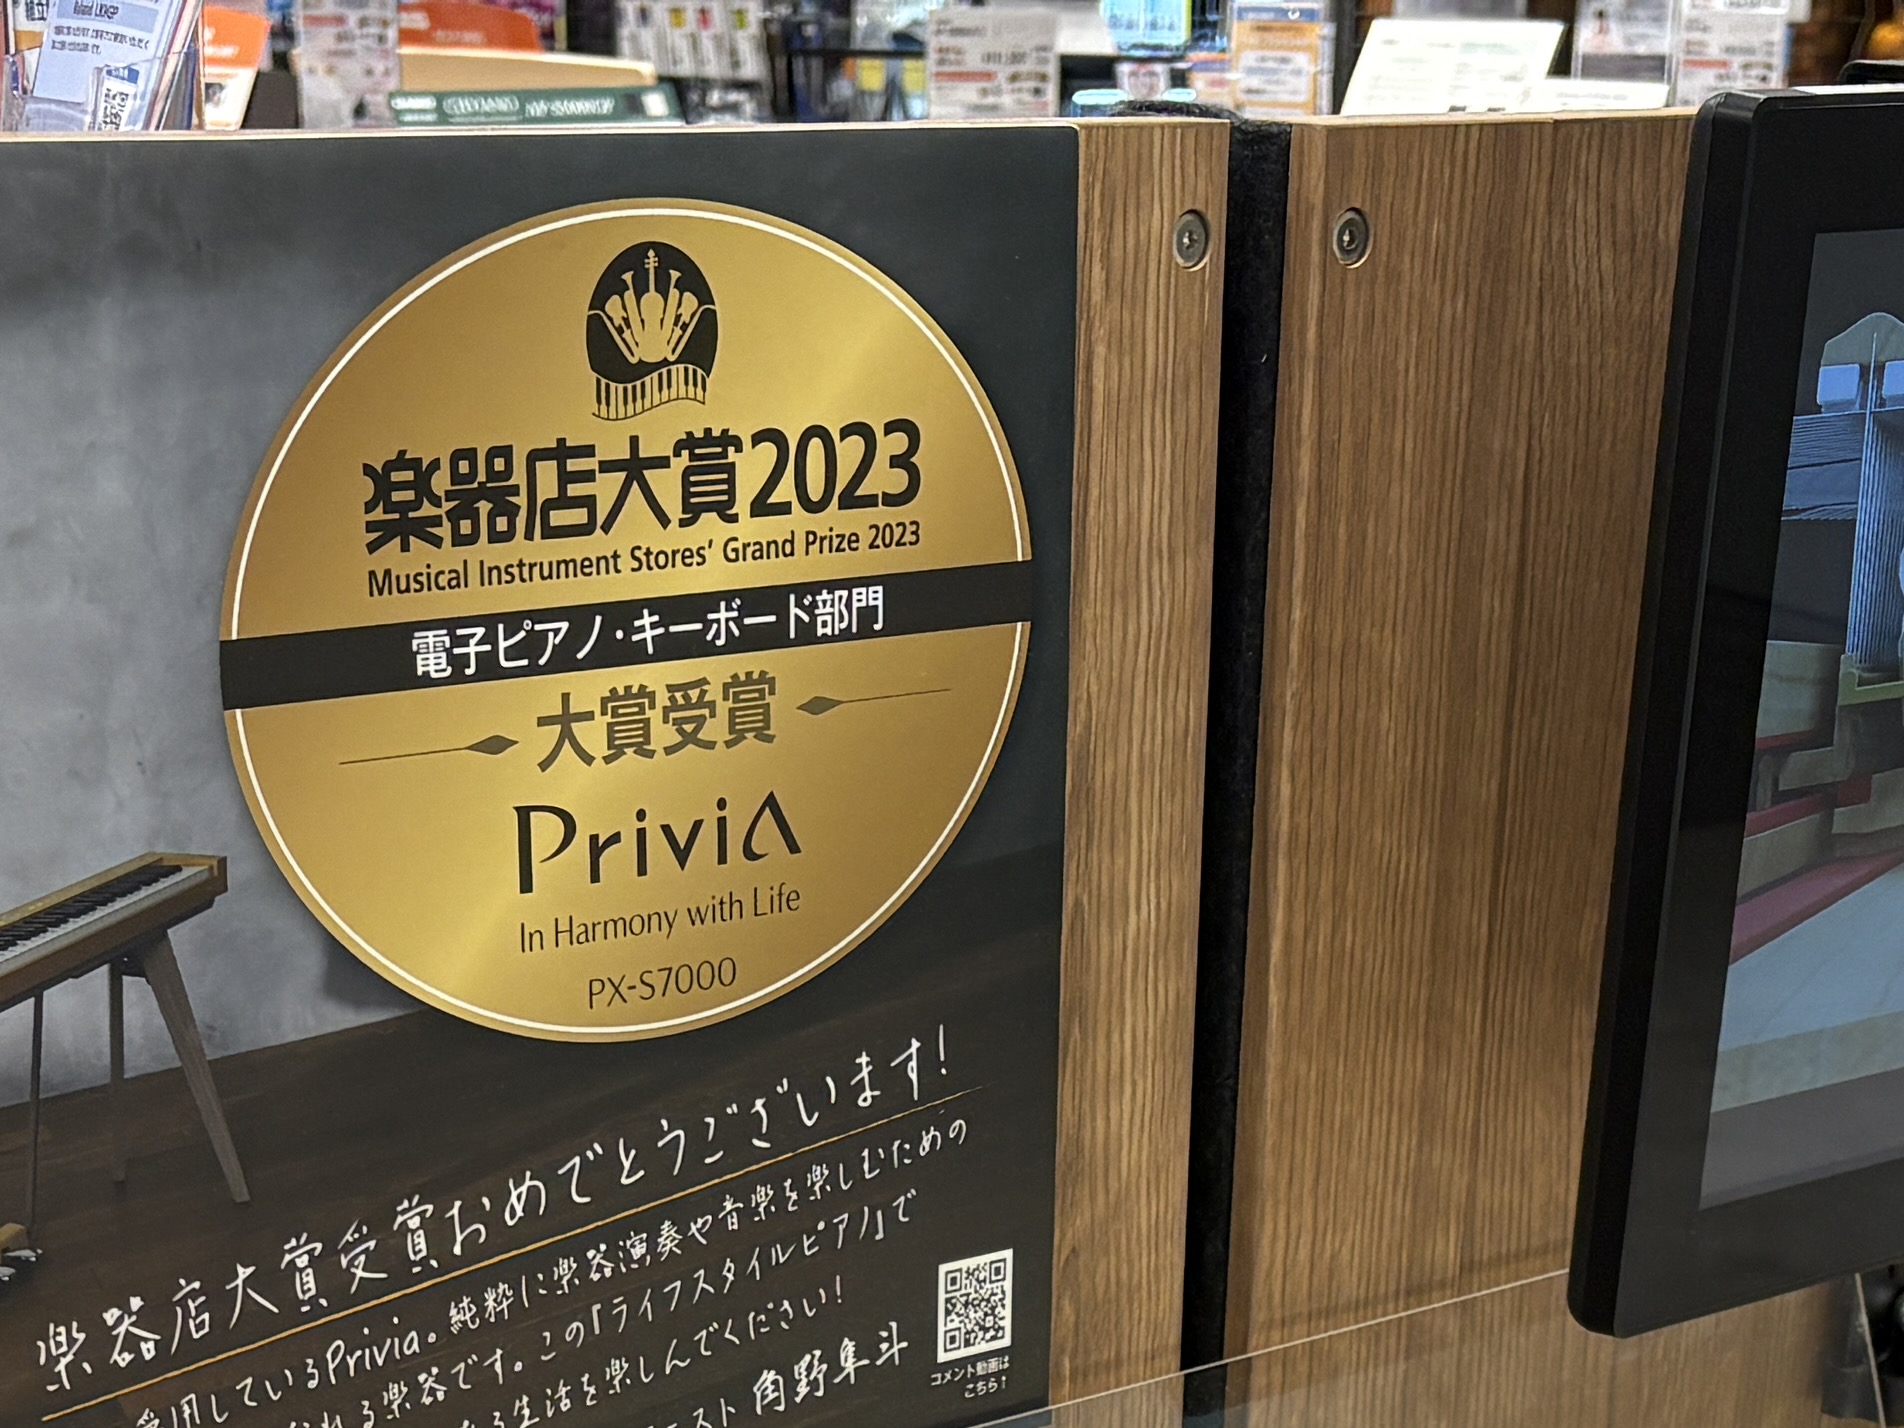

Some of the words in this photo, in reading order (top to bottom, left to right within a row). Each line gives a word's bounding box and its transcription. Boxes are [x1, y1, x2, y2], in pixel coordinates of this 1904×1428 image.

[361, 419, 922, 556] 楽器店大賞2023
[367, 560, 469, 598] Musical
[479, 555, 621, 588] Instrument
[723, 529, 796, 564] Grand
[804, 529, 860, 559] Prize
[868, 520, 921, 551] 2023
[411, 584, 885, 680] 電子ピアノ・キーボード部門
[536, 669, 777, 773] 大賞受賞
[520, 922, 544, 953] In
[554, 908, 678, 948] Harmony
[687, 890, 744, 926] with
[753, 881, 801, 917] Life
[588, 956, 737, 1010] PX-S7000
[752, 1321, 910, 1417] 角野隼斗
